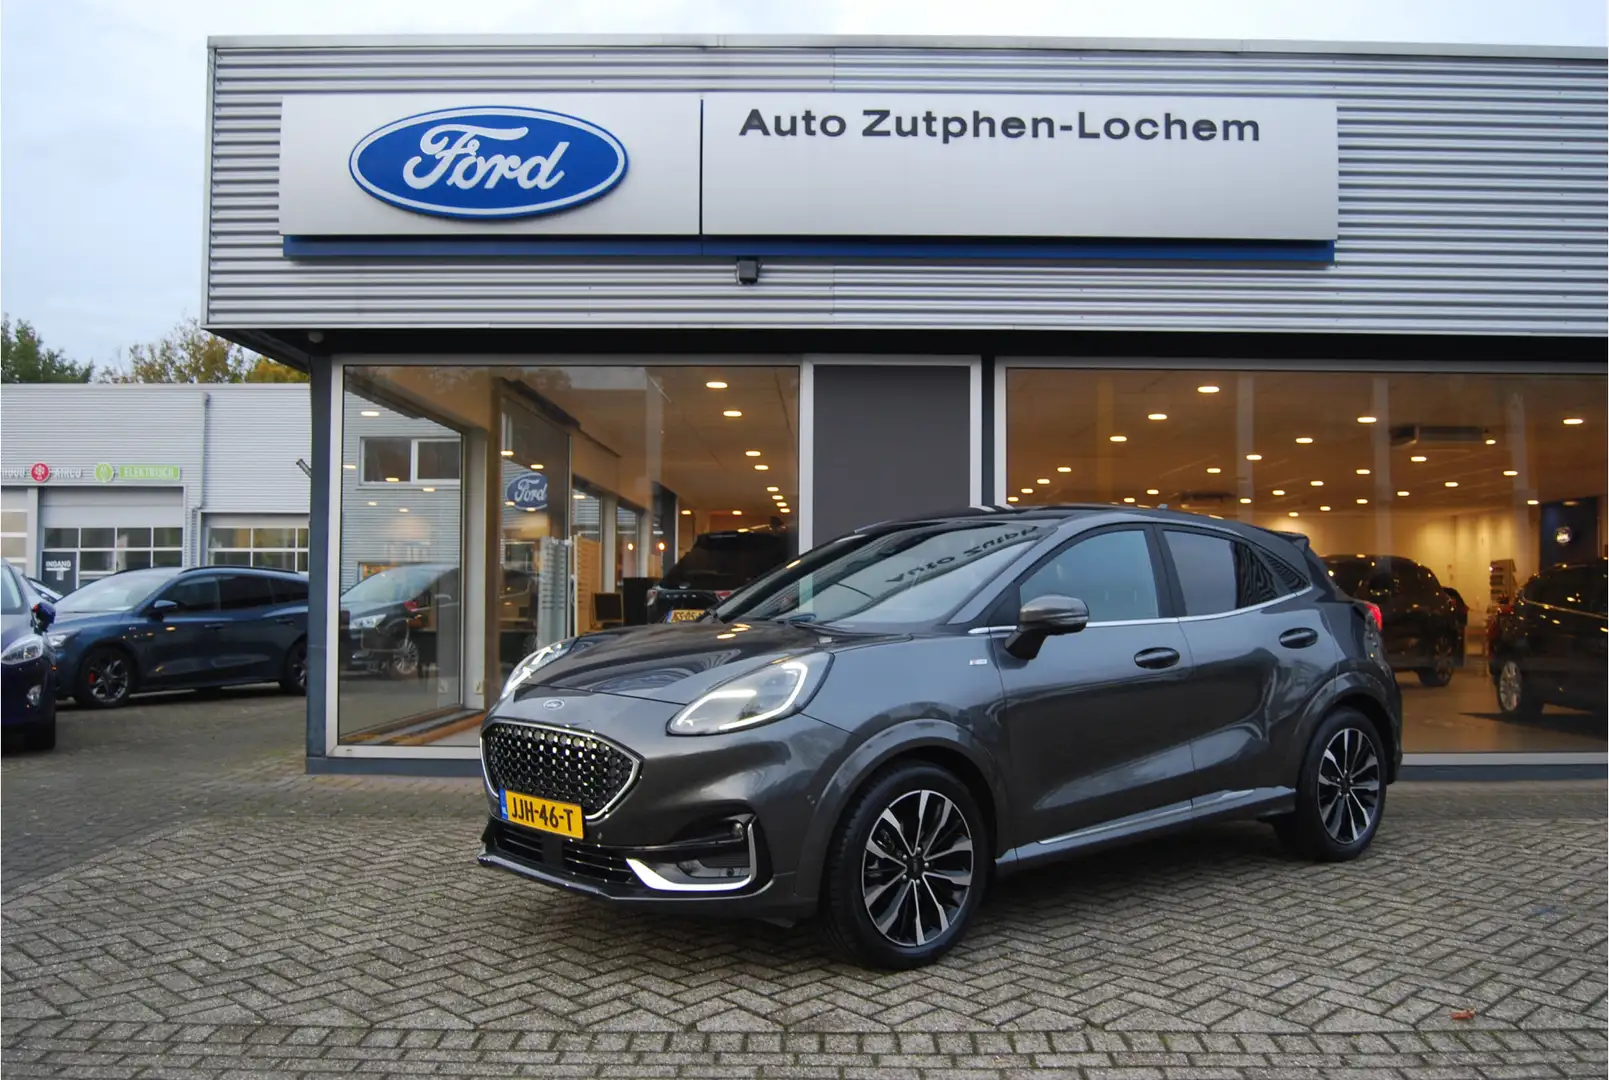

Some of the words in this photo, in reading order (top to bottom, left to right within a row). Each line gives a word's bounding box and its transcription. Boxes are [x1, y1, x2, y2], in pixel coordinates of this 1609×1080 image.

[739, 109, 847, 138] Auto
[862, 110, 1260, 144] Zutphen-Lochem
[403, 124, 570, 189] Ford
[514, 478, 548, 502] Ford
[511, 796, 574, 831] JJH-46-T
